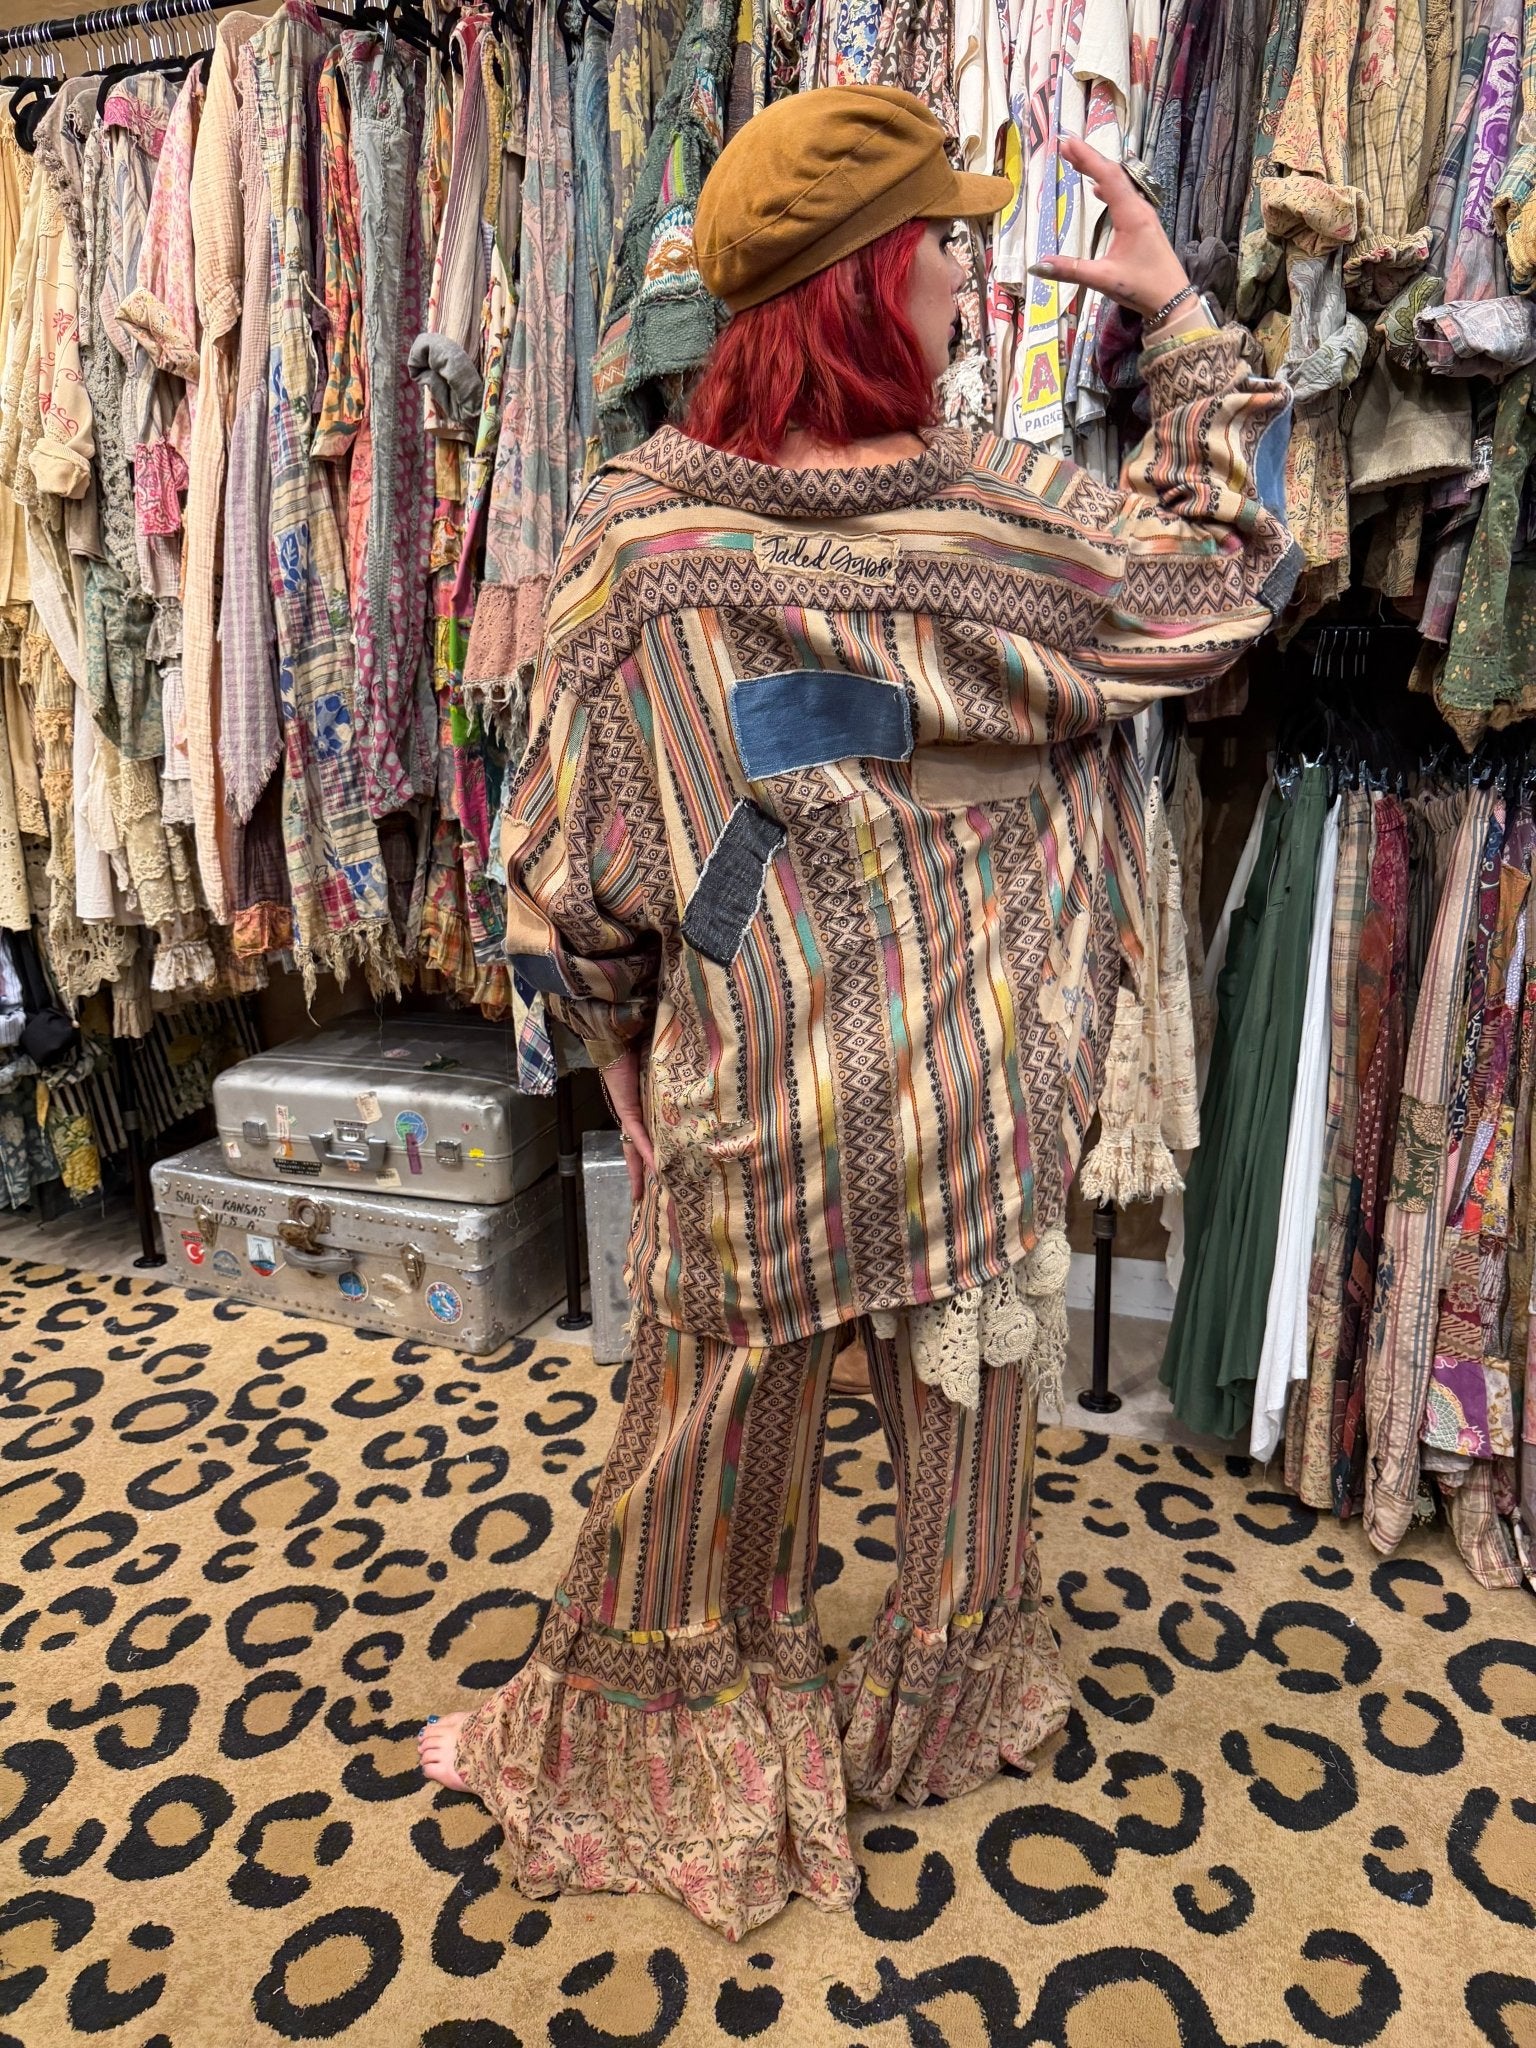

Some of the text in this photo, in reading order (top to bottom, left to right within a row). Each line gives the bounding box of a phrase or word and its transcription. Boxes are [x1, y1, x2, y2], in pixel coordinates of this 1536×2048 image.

[1028, 352, 1059, 402] A
[762, 536, 832, 570] Jaded
[222, 1199, 267, 1217] KANSAS
